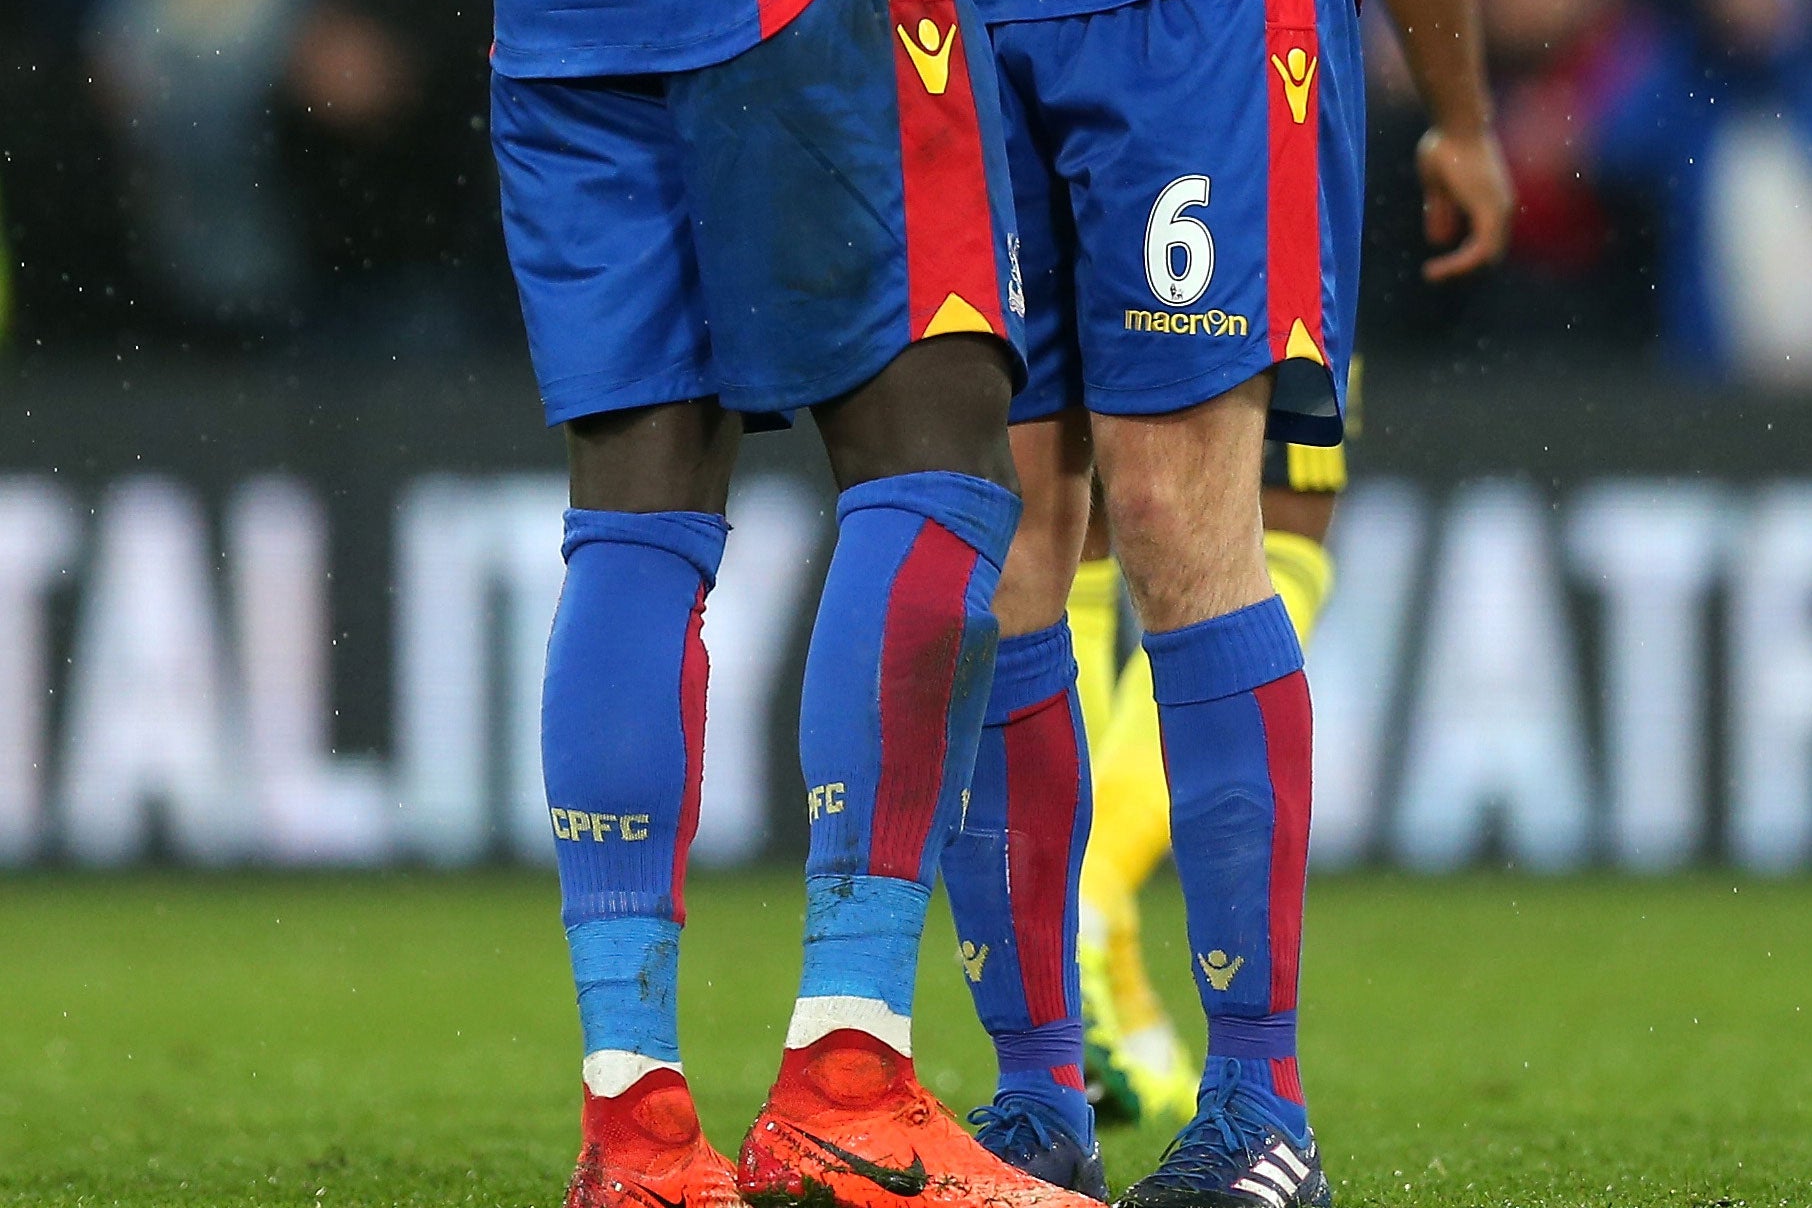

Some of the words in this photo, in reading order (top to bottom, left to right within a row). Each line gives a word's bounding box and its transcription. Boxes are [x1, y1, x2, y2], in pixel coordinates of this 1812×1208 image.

[1144, 174, 1215, 307] 6
[1124, 309, 1249, 337] macron
[807, 782, 845, 825] FC
[550, 807, 651, 843] CPFC
